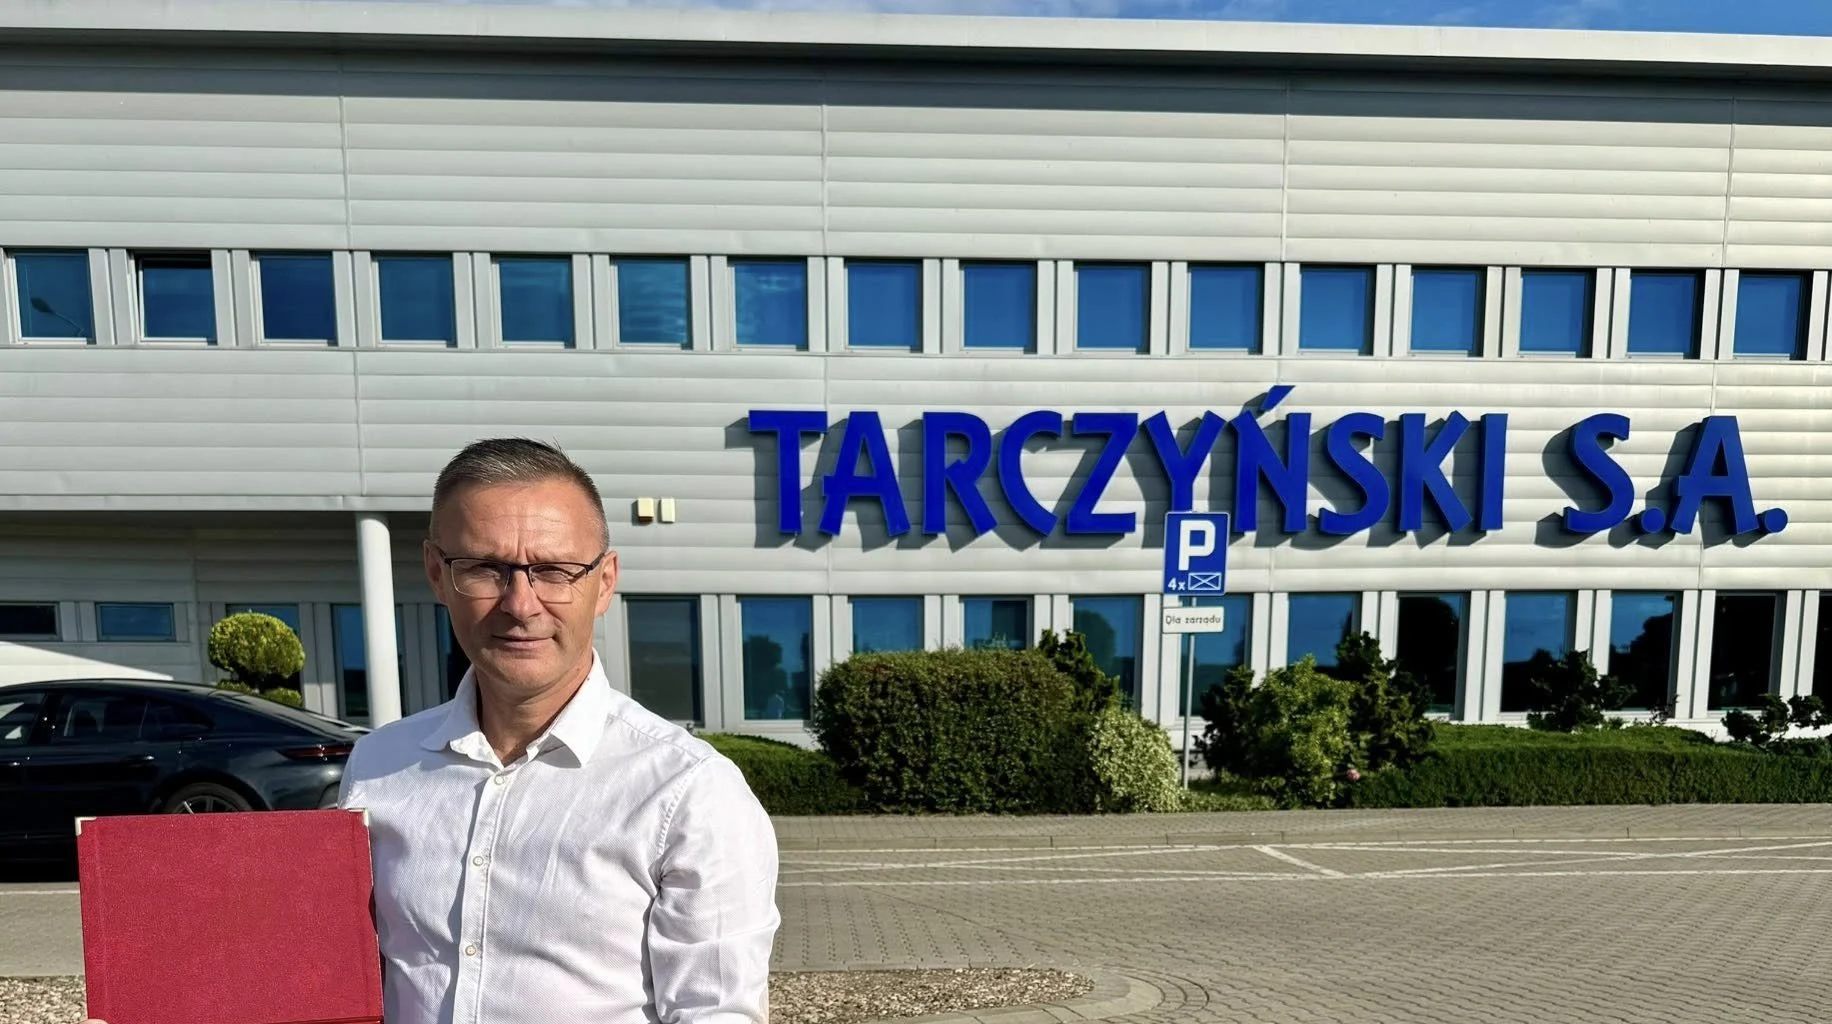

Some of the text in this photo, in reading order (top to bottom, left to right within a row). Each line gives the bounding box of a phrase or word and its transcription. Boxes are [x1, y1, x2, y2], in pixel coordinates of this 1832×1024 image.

[748, 384, 1788, 537] TARCZYŃSKI S.A.
[1178, 519, 1216, 571] P
[1165, 613, 1181, 625] Dla
